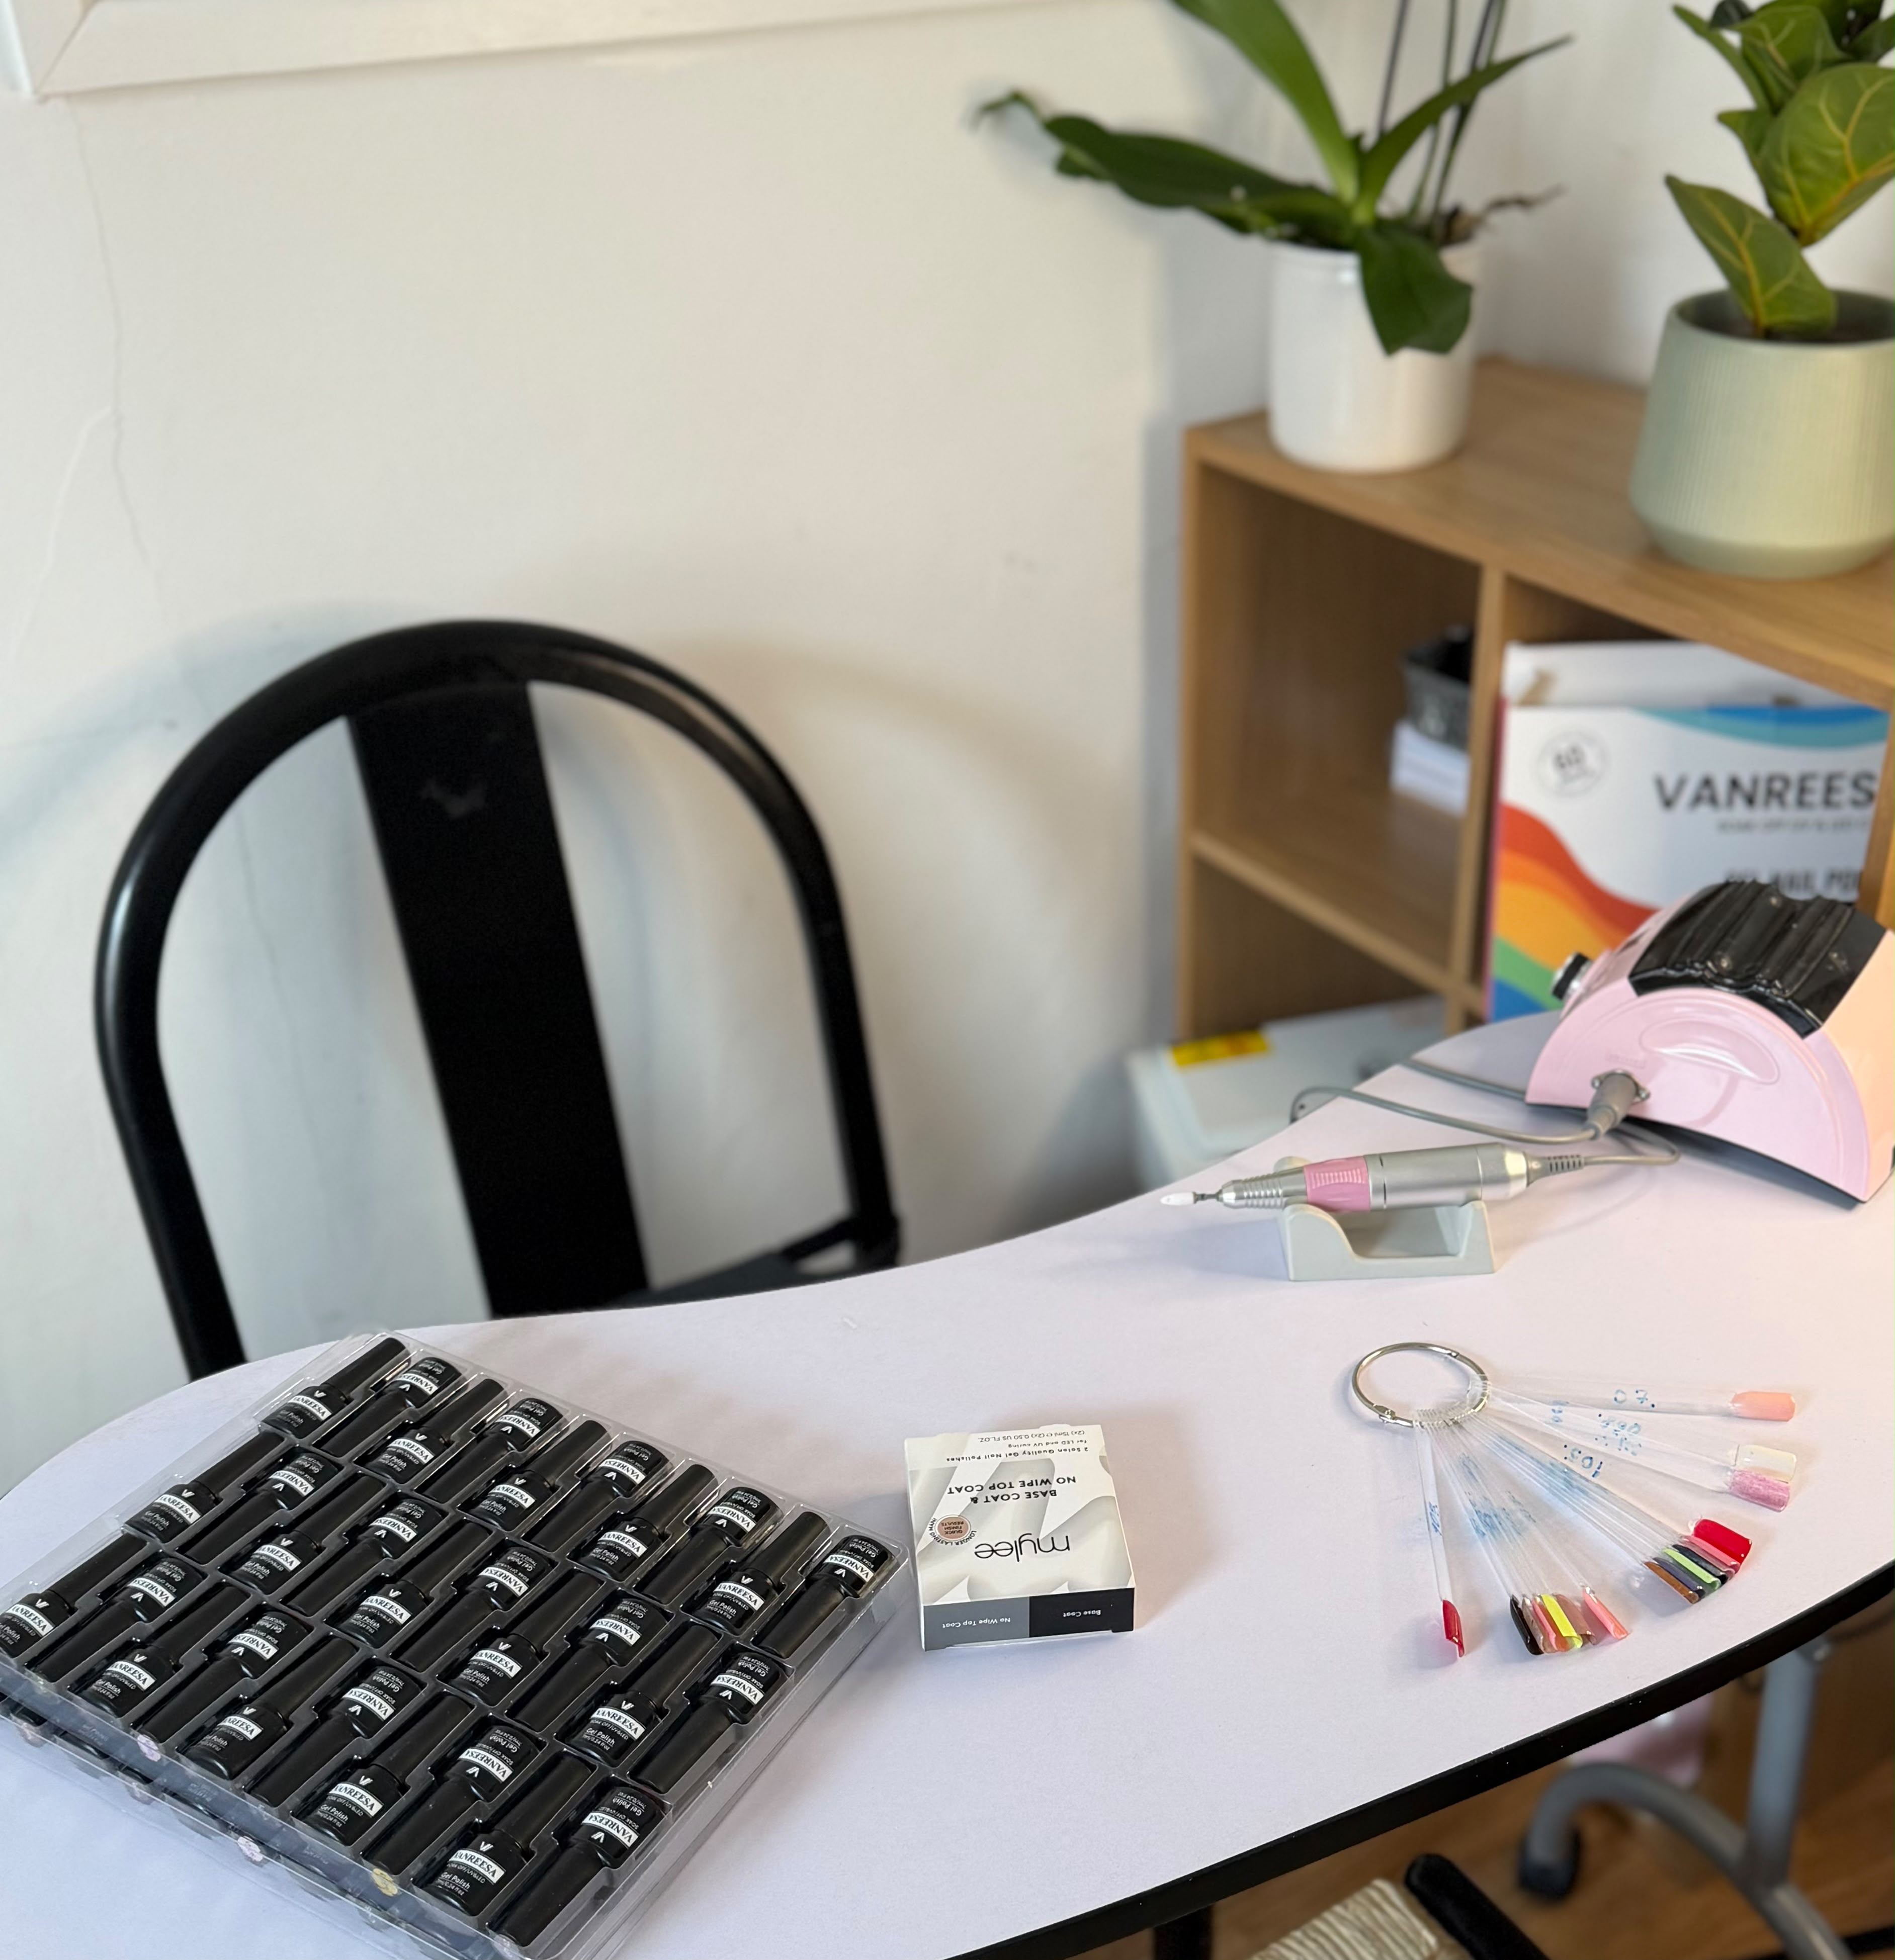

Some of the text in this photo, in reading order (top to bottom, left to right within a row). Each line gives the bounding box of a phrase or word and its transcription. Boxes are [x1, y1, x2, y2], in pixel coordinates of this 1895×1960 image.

[1656, 773, 1877, 810] VANREES
[948, 1485, 984, 1494] COAT
[989, 1482, 1014, 1490] TOP
[1019, 1478, 1052, 1488] WIPE
[984, 1493, 1020, 1503] COAT
[1025, 1489, 1057, 1499] BASE
[865, 1549, 877, 1558] Gel
[975, 1533, 1070, 1562] mylee
[738, 1660, 766, 1677] Gel Polish
[387, 1683, 400, 1692] Gel
[717, 1677, 758, 1700] VANREESA
[596, 1710, 639, 1735] VANREESA
[489, 1735, 518, 1753] Gel Polish
[596, 1731, 615, 1746] Polish
[330, 1807, 349, 1821] Polish
[612, 1797, 642, 1816] Gel Polish
[588, 1815, 633, 1843] VANREESA
[625, 1817, 640, 1830] SOAK
[454, 1852, 497, 1878] VANREESA
[452, 1875, 471, 1890] Polish
